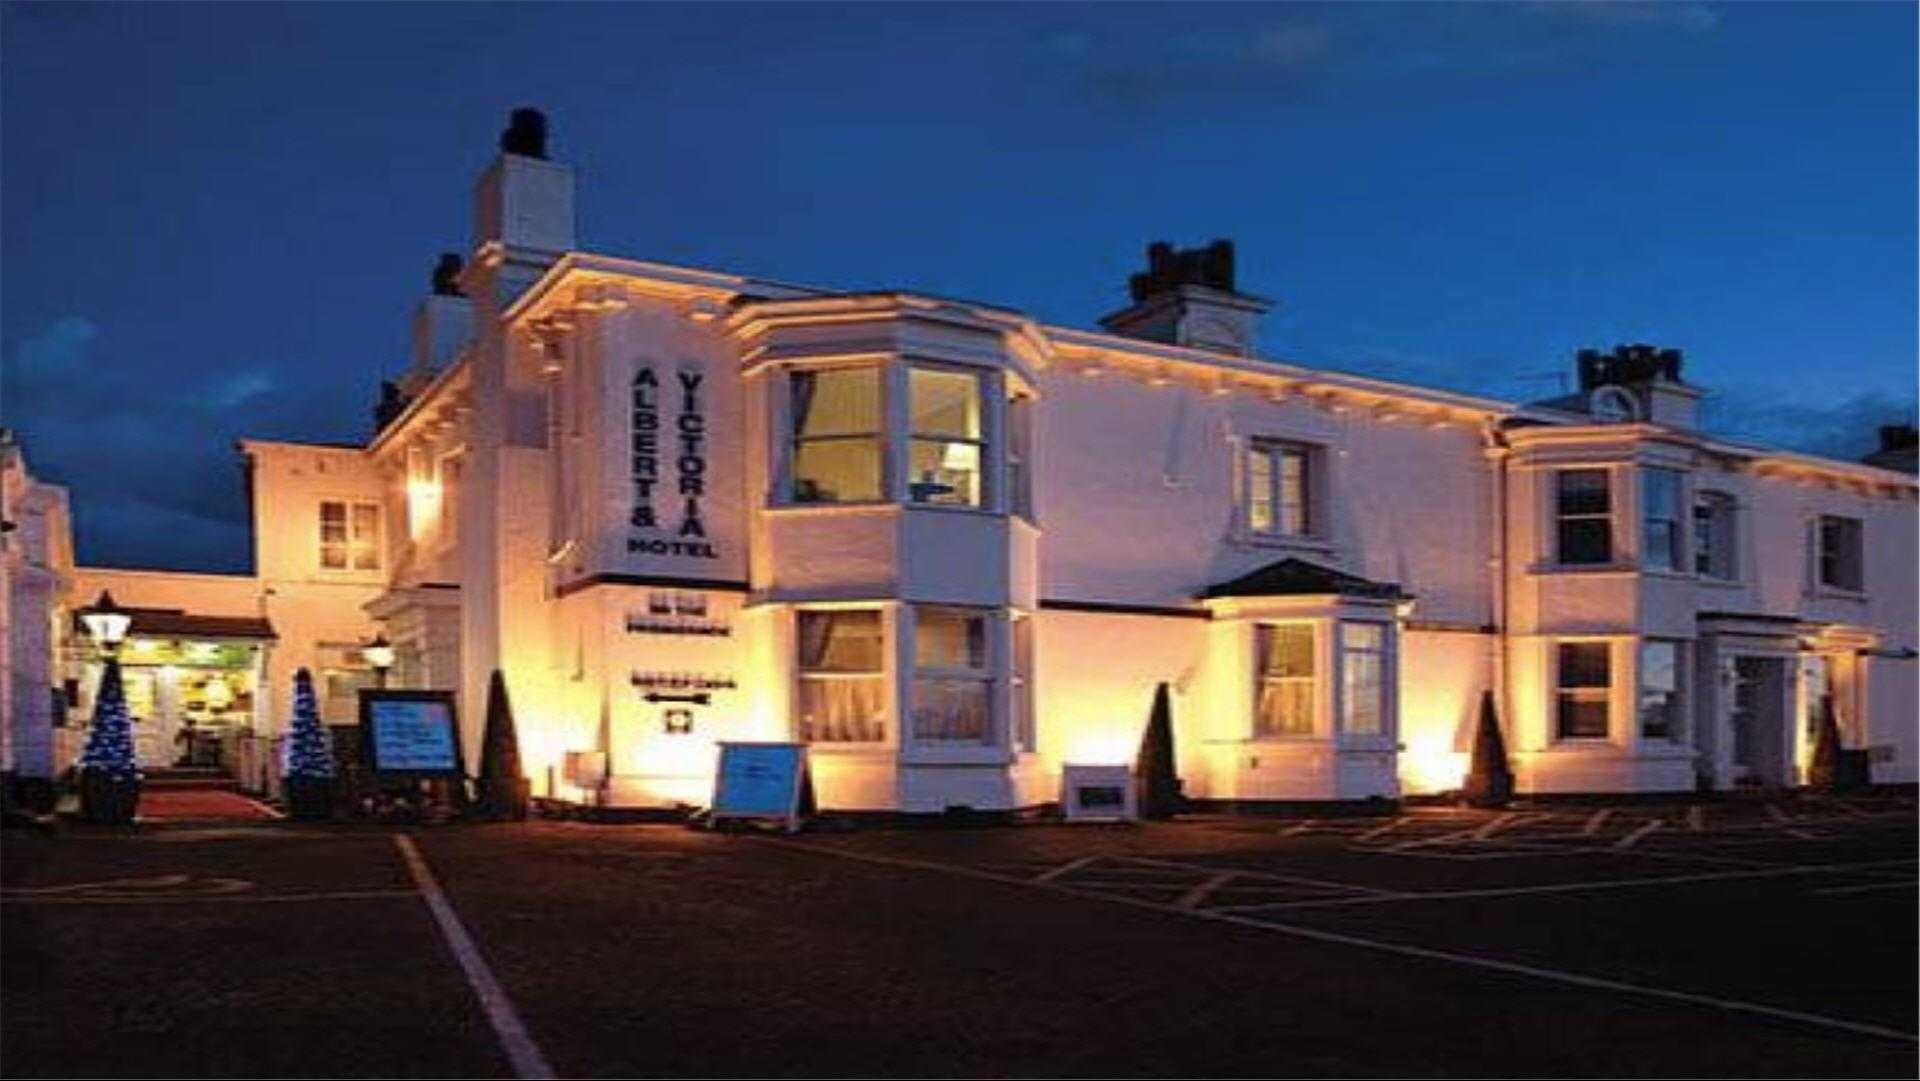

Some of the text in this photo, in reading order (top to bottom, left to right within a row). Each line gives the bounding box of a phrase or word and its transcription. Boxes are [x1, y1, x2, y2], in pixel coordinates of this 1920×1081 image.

[633, 367, 659, 498] ALBERT
[677, 371, 706, 537] VICTORIA
[627, 539, 719, 559] HOTEL
